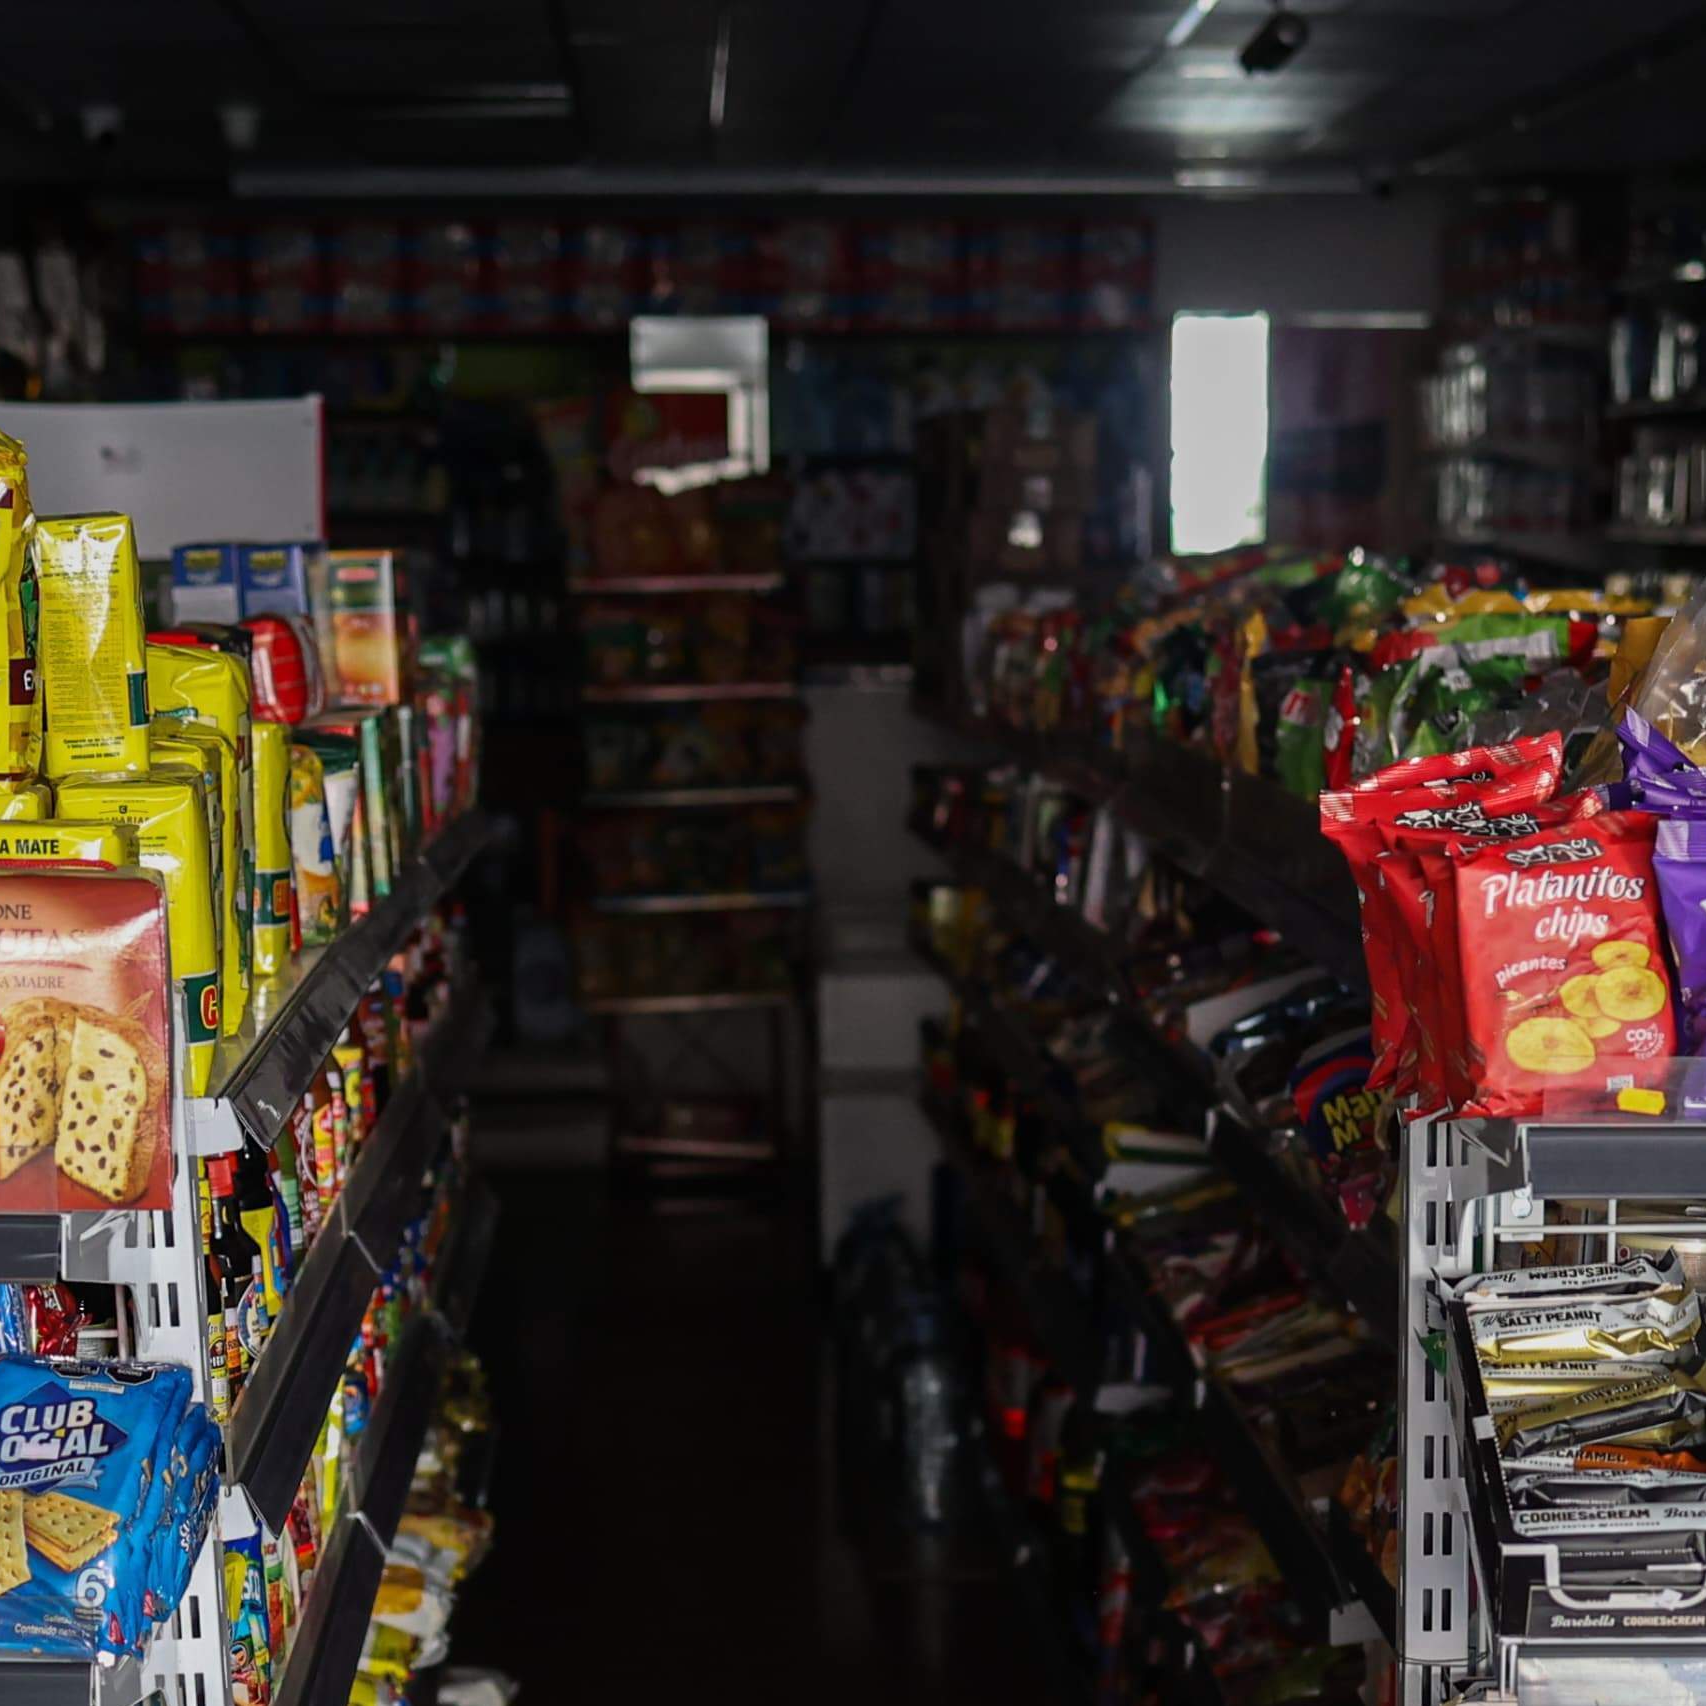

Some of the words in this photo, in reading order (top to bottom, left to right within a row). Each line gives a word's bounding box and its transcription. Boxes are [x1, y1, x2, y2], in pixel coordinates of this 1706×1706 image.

[15, 838, 60, 855] MATE
[1479, 867, 1645, 912] Platanitos
[1534, 904, 1609, 946] chips
[12, 974, 66, 990] MADRE
[1495, 955, 1566, 988] picantes
[1496, 1313, 1543, 1329] SALTY
[1547, 1308, 1602, 1327] PEANUT
[0, 1401, 95, 1437] CLUB
[1519, 1510, 1651, 1525] COOKIES&CREAM
[1550, 1616, 1615, 1630] Barebells
